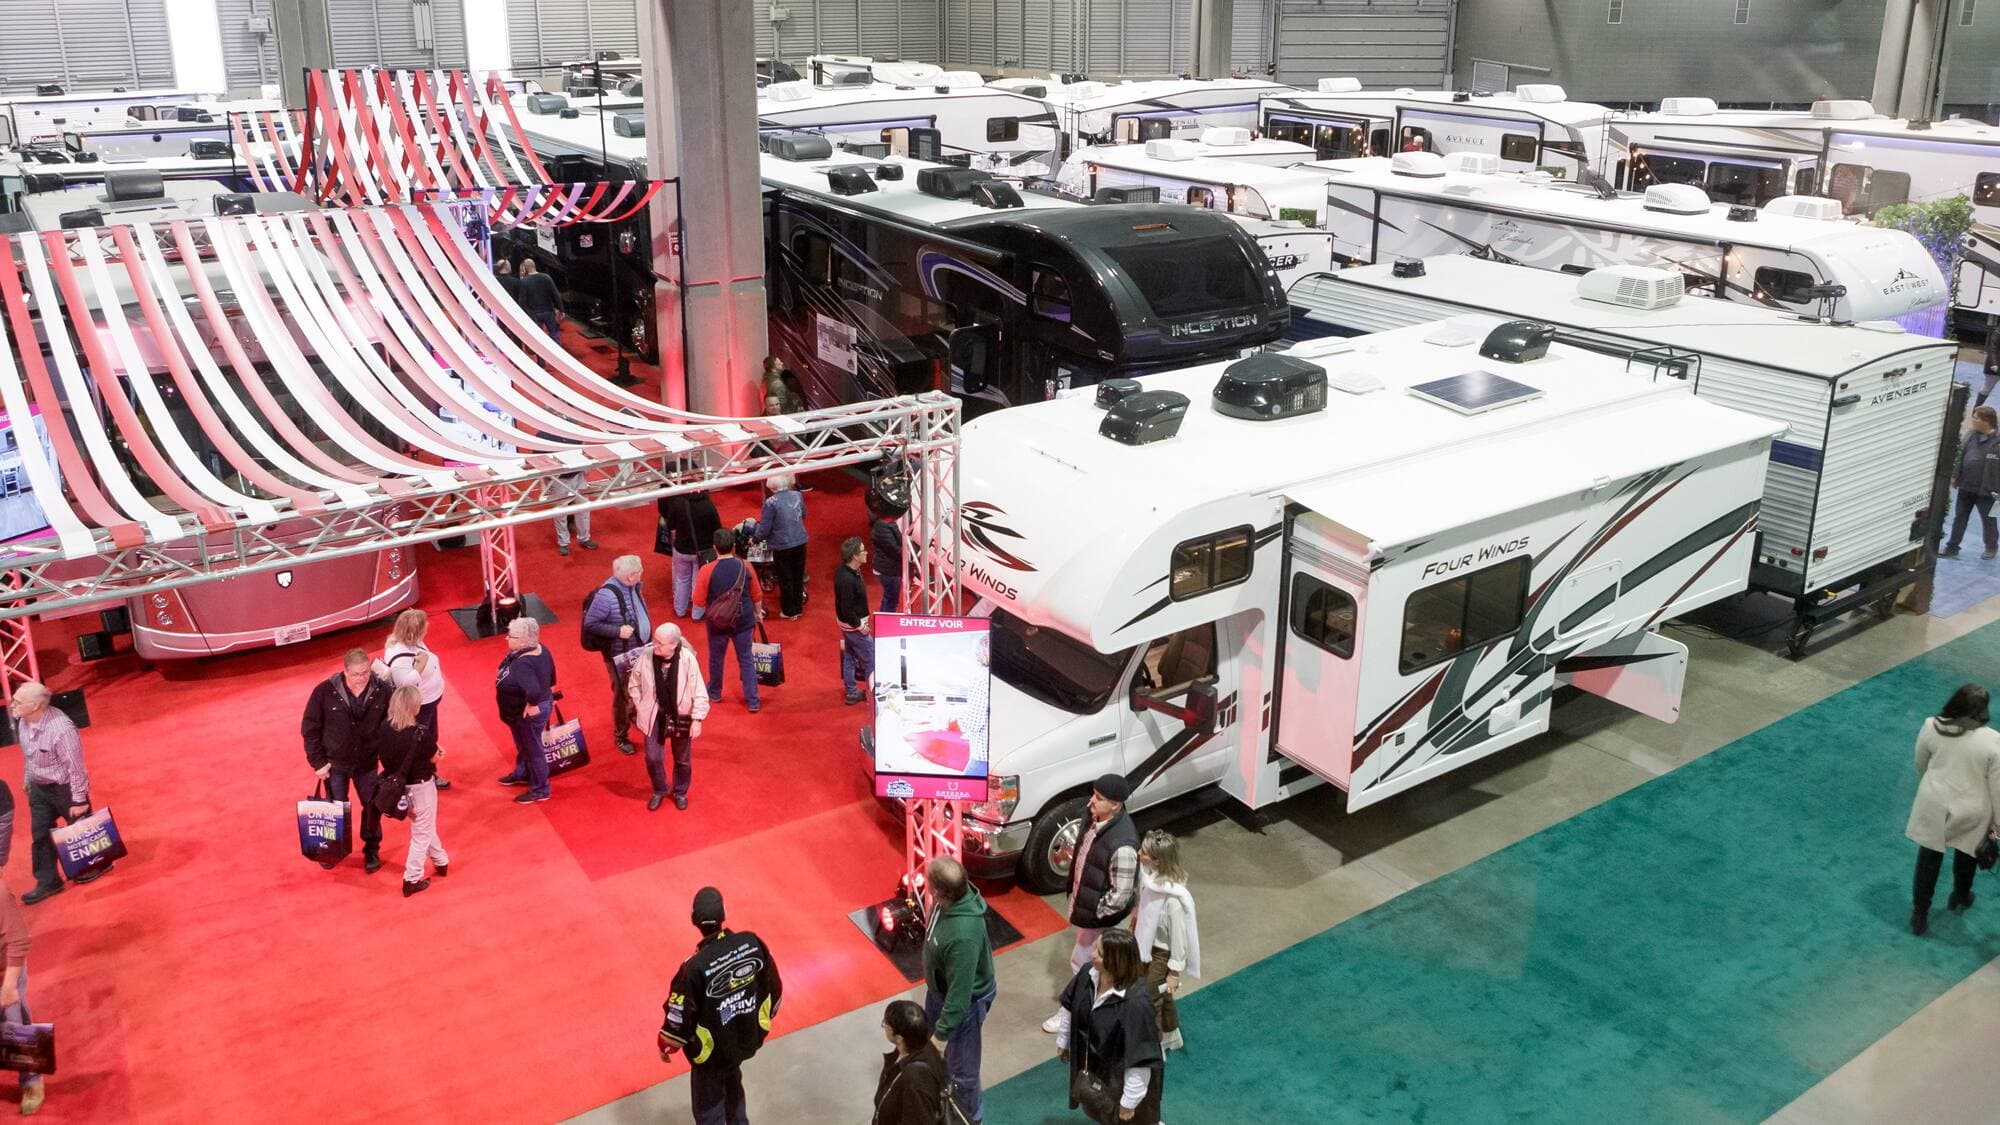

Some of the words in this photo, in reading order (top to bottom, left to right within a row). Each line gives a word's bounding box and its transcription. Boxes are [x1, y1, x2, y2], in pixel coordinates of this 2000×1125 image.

[1883, 284, 1904, 295] EAST
[1171, 313, 1258, 337] INCEPTION
[1871, 382, 1928, 406] AVENGER
[1421, 554, 1473, 580] FOUR
[1478, 536, 1531, 562] WINDS
[970, 563, 1019, 601] WINDS
[900, 618, 937, 628] ENTREZ
[939, 620, 963, 629] VOIR
[669, 992, 685, 1006] 24
